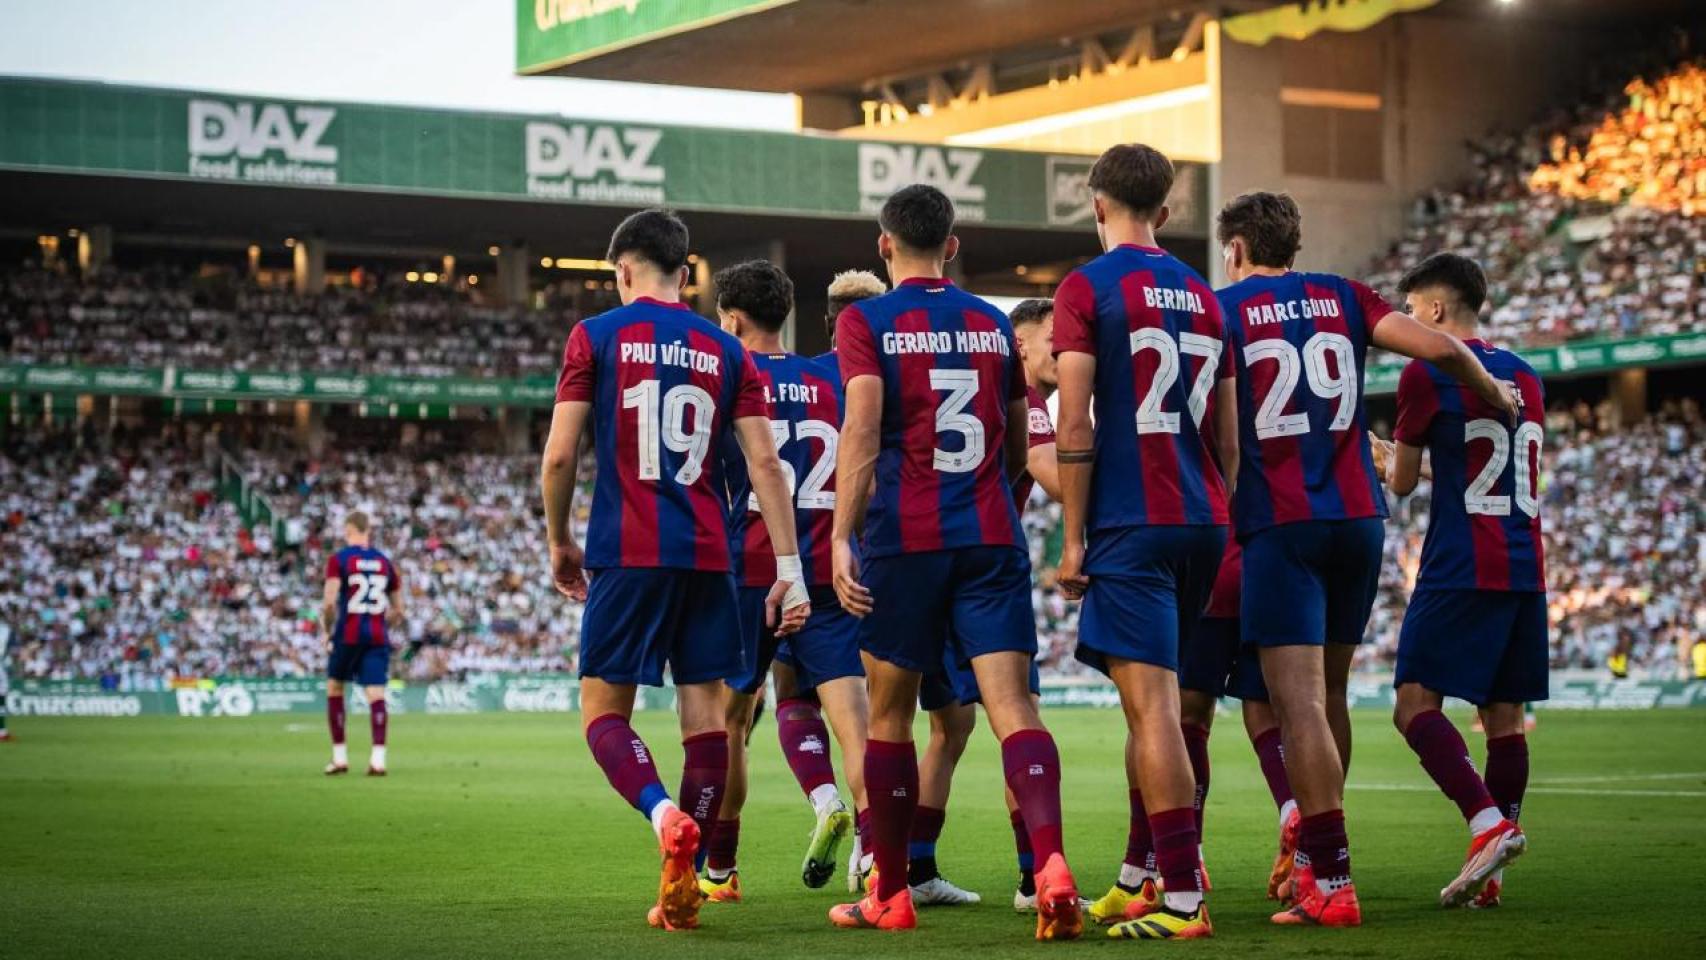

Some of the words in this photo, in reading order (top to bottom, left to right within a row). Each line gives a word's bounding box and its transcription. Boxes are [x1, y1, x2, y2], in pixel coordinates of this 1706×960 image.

[188, 100, 337, 162] DIAZ
[525, 122, 665, 180] DIAZ
[858, 143, 986, 199] DIAZ
[1143, 285, 1205, 314] BERNAL
[1246, 300, 1299, 326] MARC
[1300, 298, 1339, 319] GUIU
[620, 342, 657, 364] PAU
[660, 339, 719, 376] VÍCTOR
[882, 331, 952, 354] GERARD
[778, 383, 819, 404] FORT
[1129, 328, 1223, 434] 27
[1242, 331, 1357, 440] 29
[622, 380, 716, 486] 19
[928, 368, 986, 473] 3
[1464, 418, 1544, 519] 20
[347, 573, 389, 615] 23
